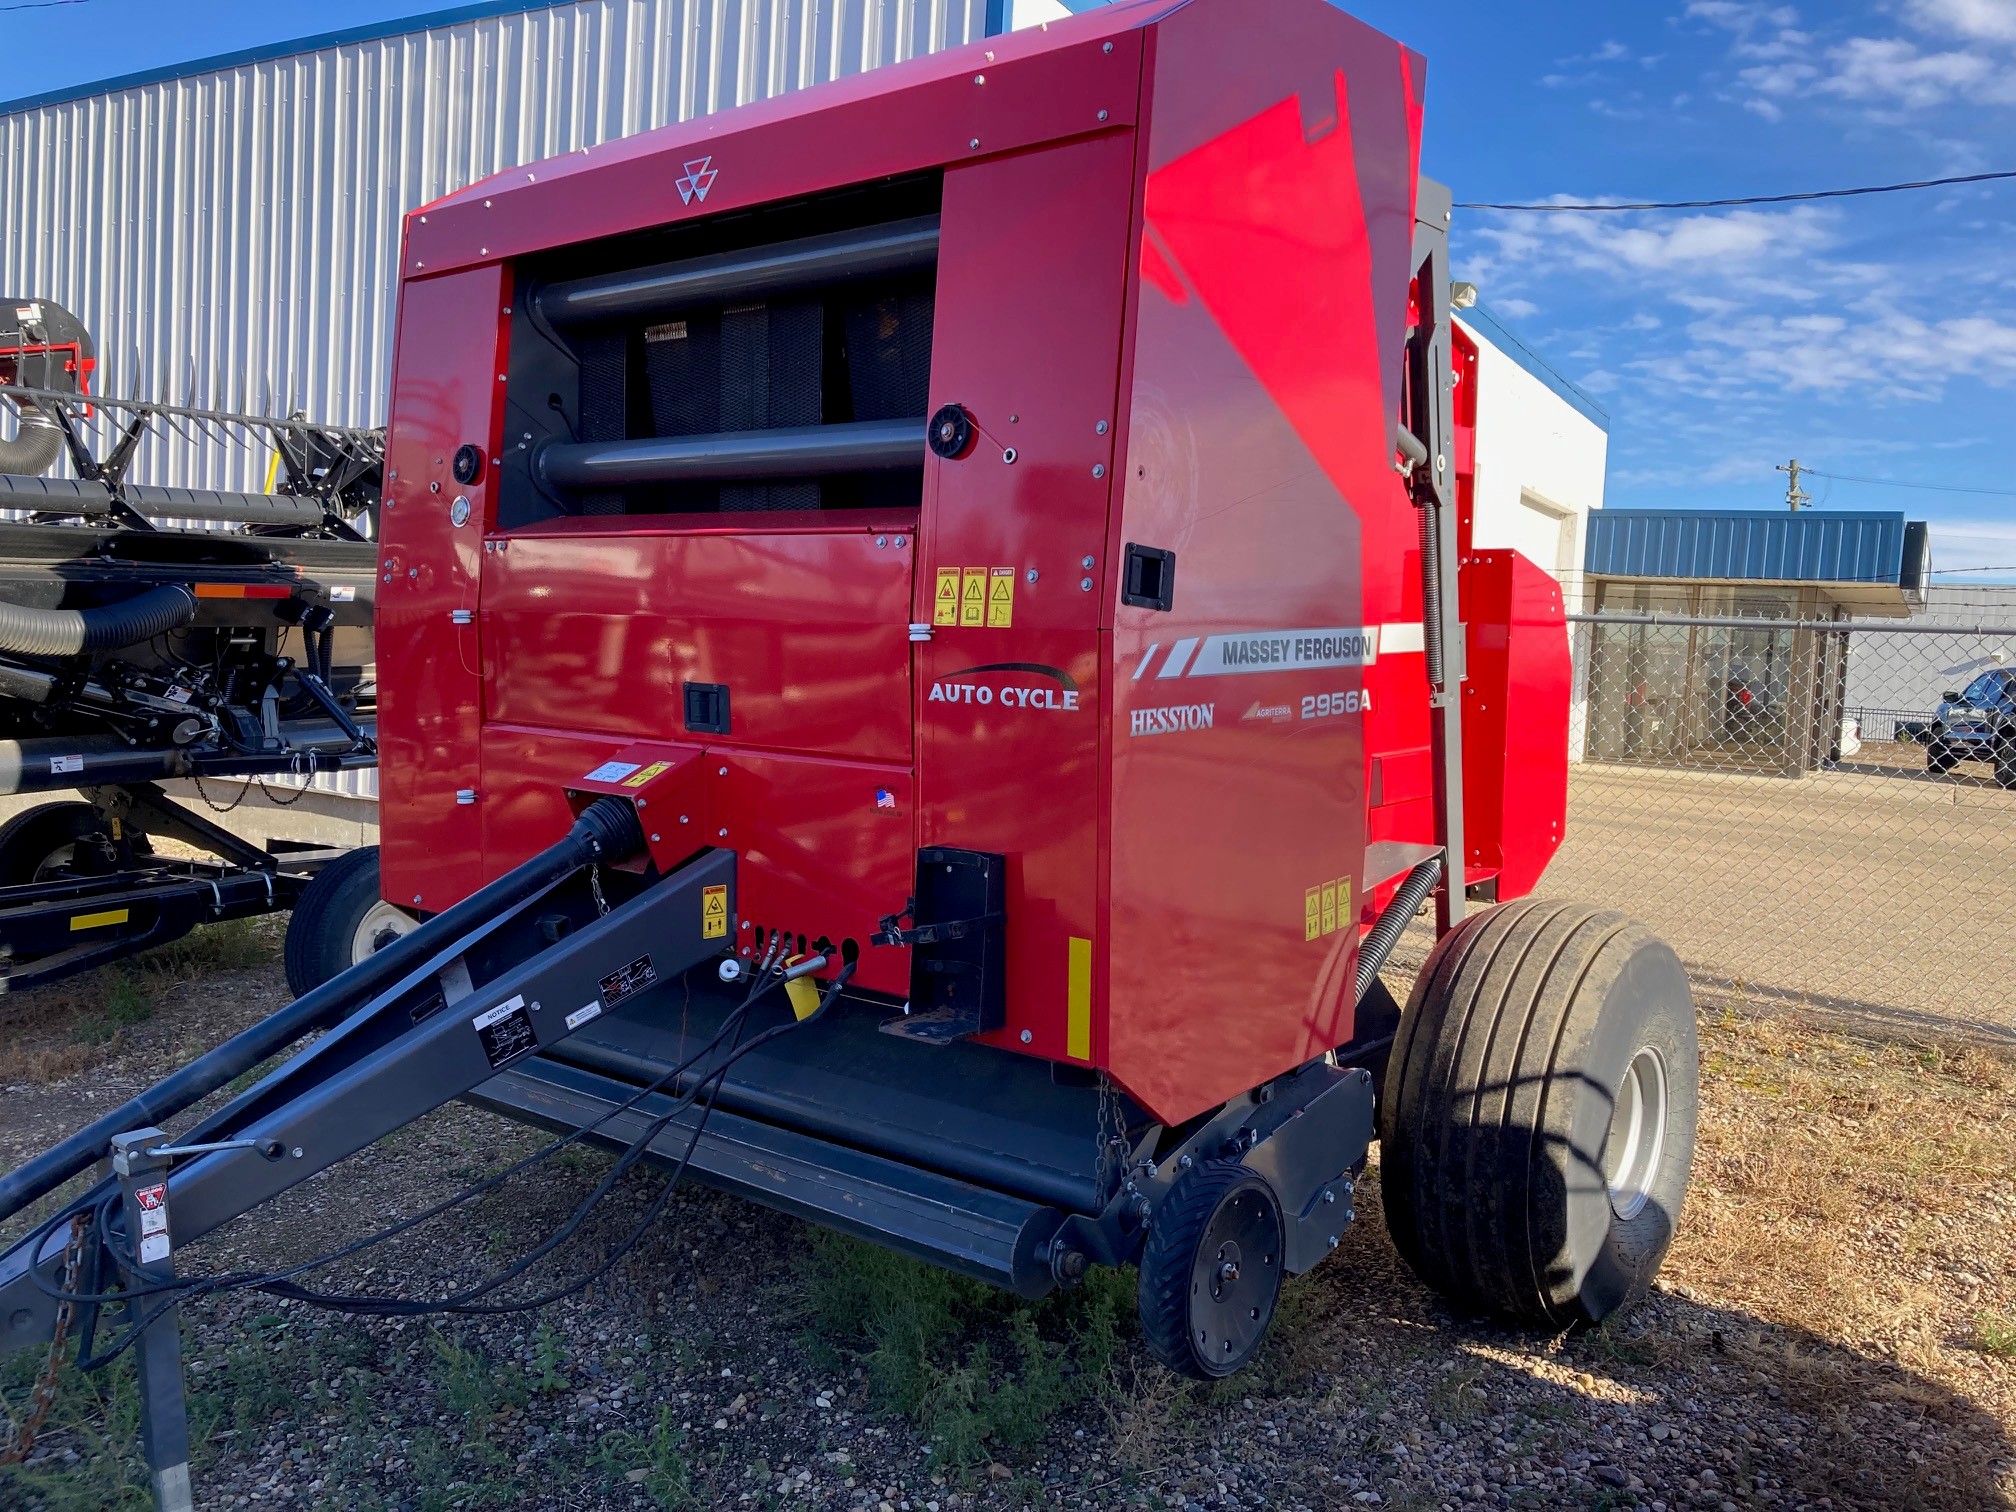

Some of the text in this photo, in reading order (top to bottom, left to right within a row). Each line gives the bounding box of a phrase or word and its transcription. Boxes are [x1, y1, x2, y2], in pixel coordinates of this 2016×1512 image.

[1222, 636, 1371, 665] MASSEY FERGUSON
[928, 683, 1079, 710] AUTO CYCLE
[1301, 688, 1372, 719] 2956A
[1130, 703, 1215, 737] HESSTON
[1256, 705, 1292, 718] AGRITERRA
[487, 1004, 511, 1020] NOTICE
